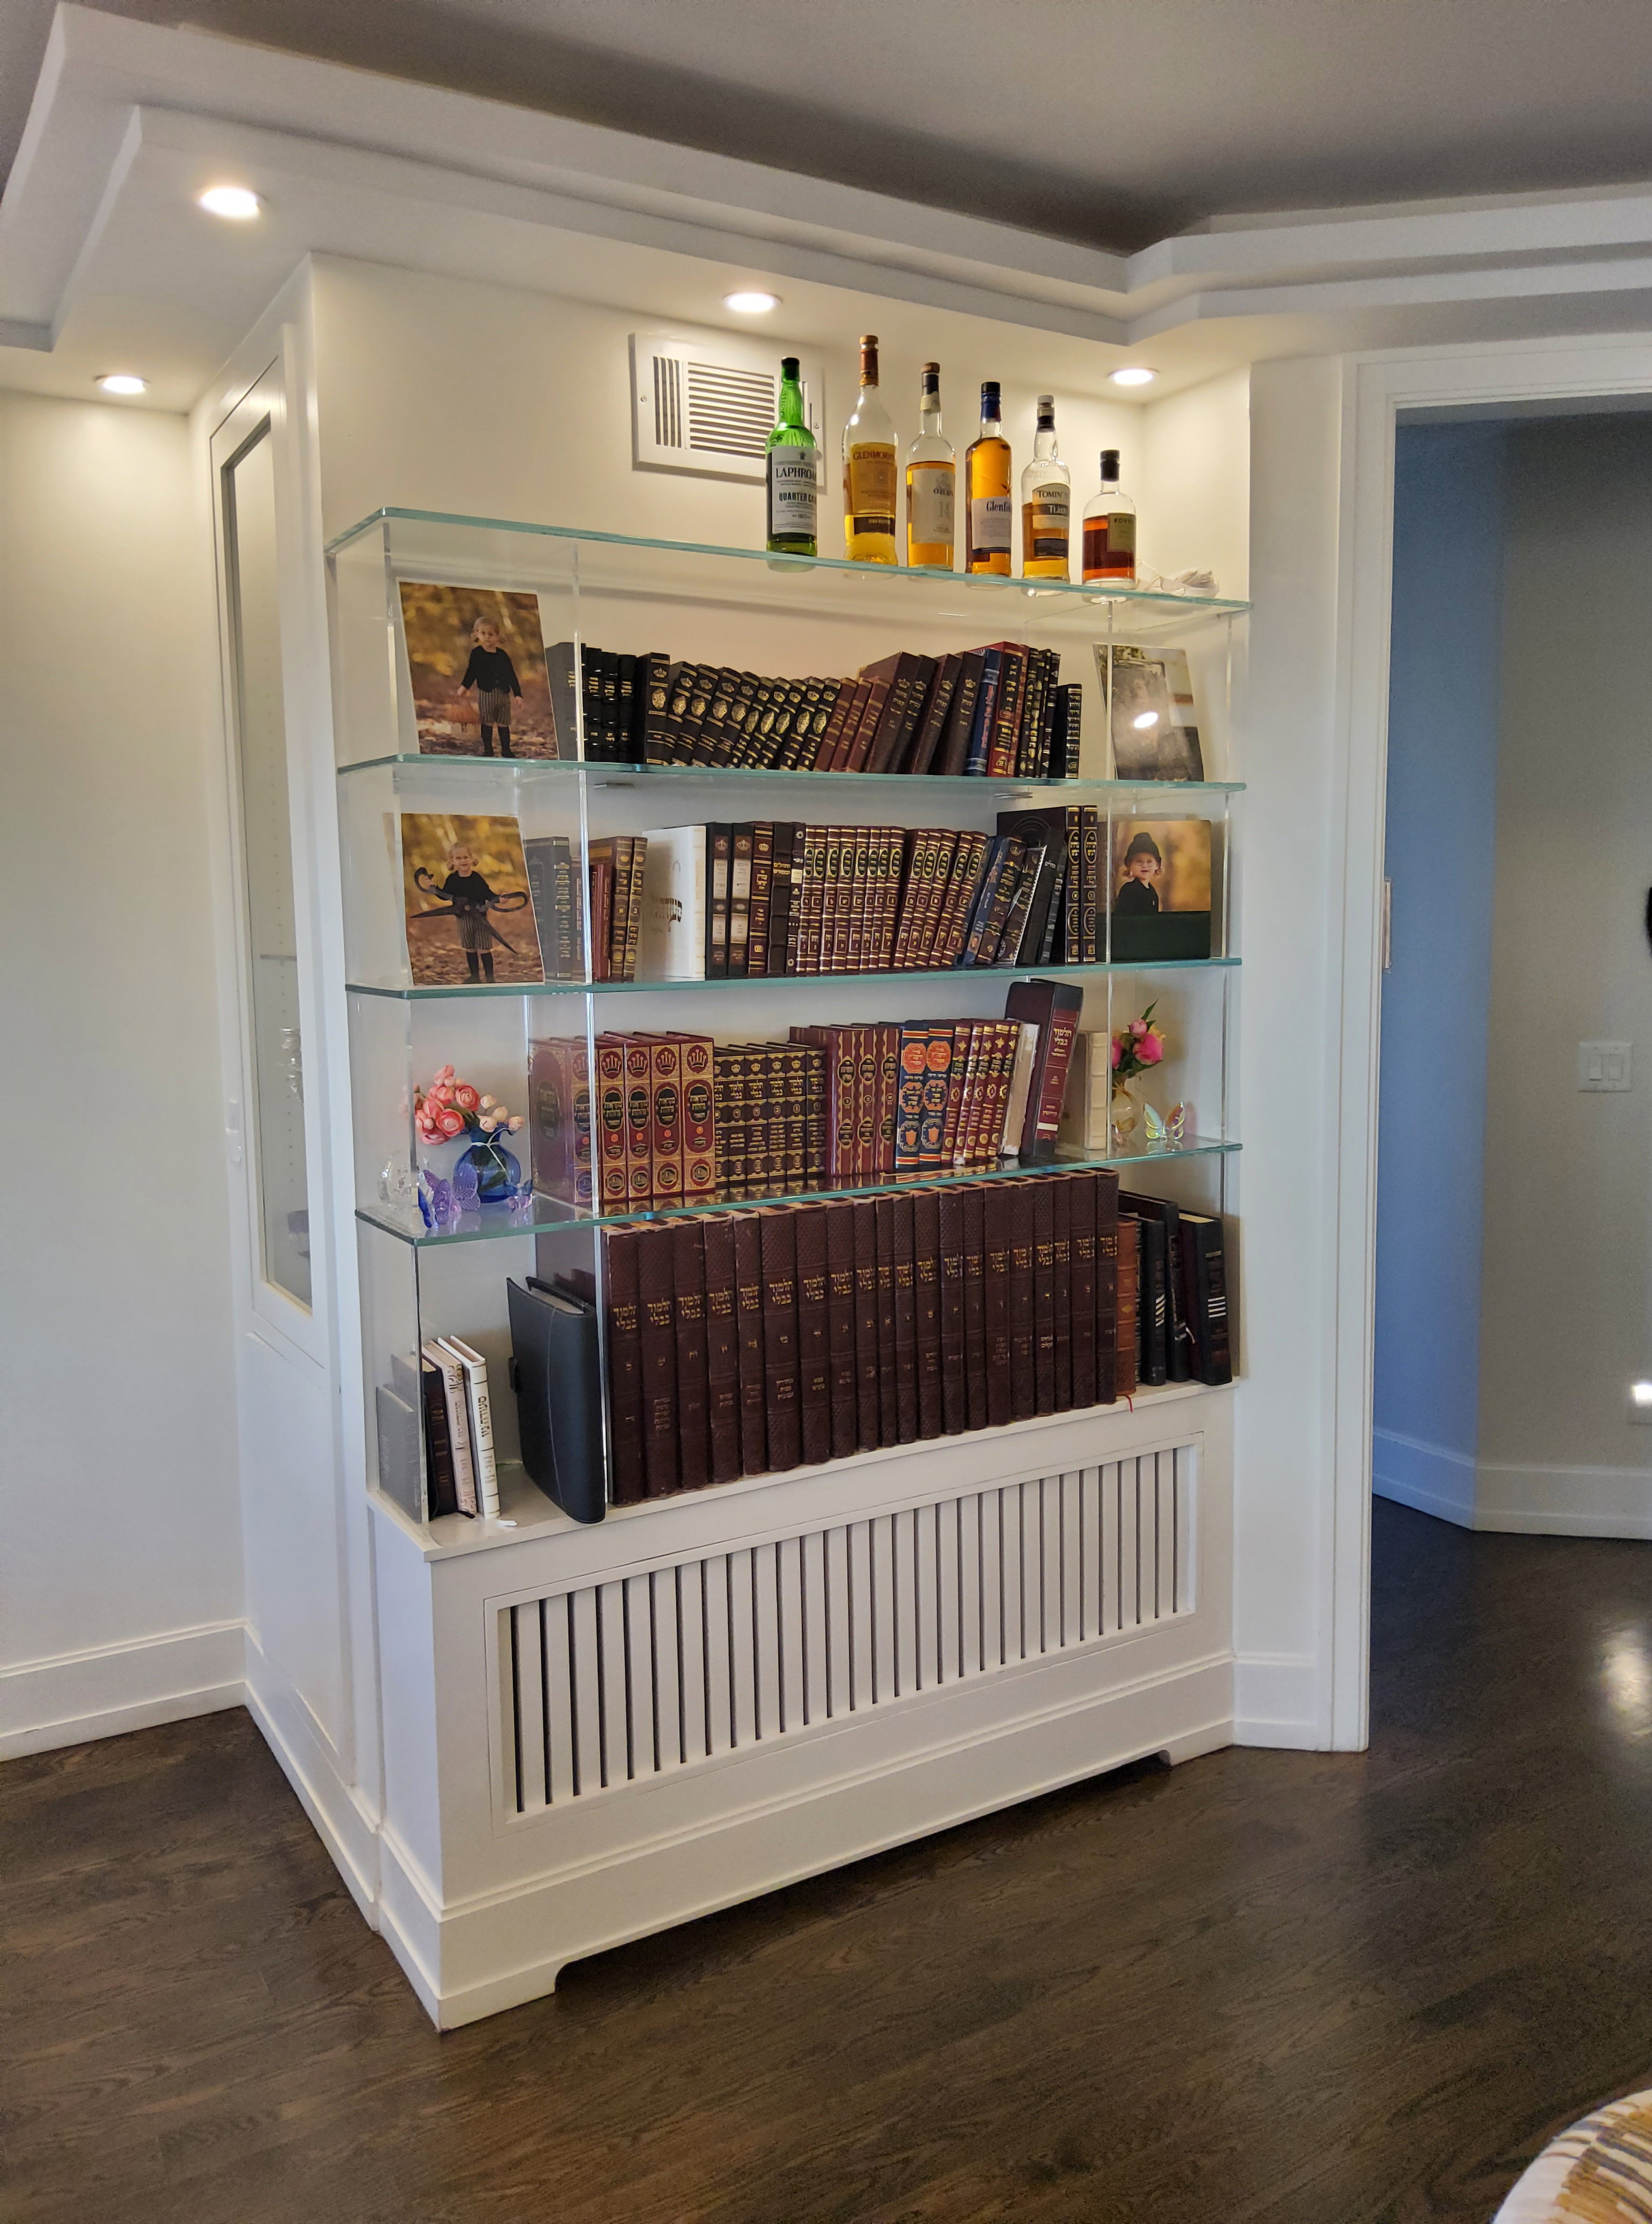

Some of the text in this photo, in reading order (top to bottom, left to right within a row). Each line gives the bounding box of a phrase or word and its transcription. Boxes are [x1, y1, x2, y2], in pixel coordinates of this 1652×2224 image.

[779, 492, 807, 502] QUARTER
[1053, 1027, 1072, 1038] תלמוד
[1054, 1037, 1068, 1046] בבלי
[769, 1278, 793, 1292] תלמוד
[803, 1275, 826, 1288] תלמוד
[709, 1287, 733, 1302] תלמוד
[806, 1288, 824, 1301] בבלי
[834, 1283, 852, 1295] בבלי
[647, 1298, 671, 1312] תלמוד
[742, 1297, 759, 1310] בבלי
[772, 1292, 792, 1305] בבלי
[681, 1306, 701, 1319] בבלי
[712, 1302, 732, 1315] בבלי
[616, 1317, 637, 1330] בבלי
[650, 1312, 670, 1326] בבלי
